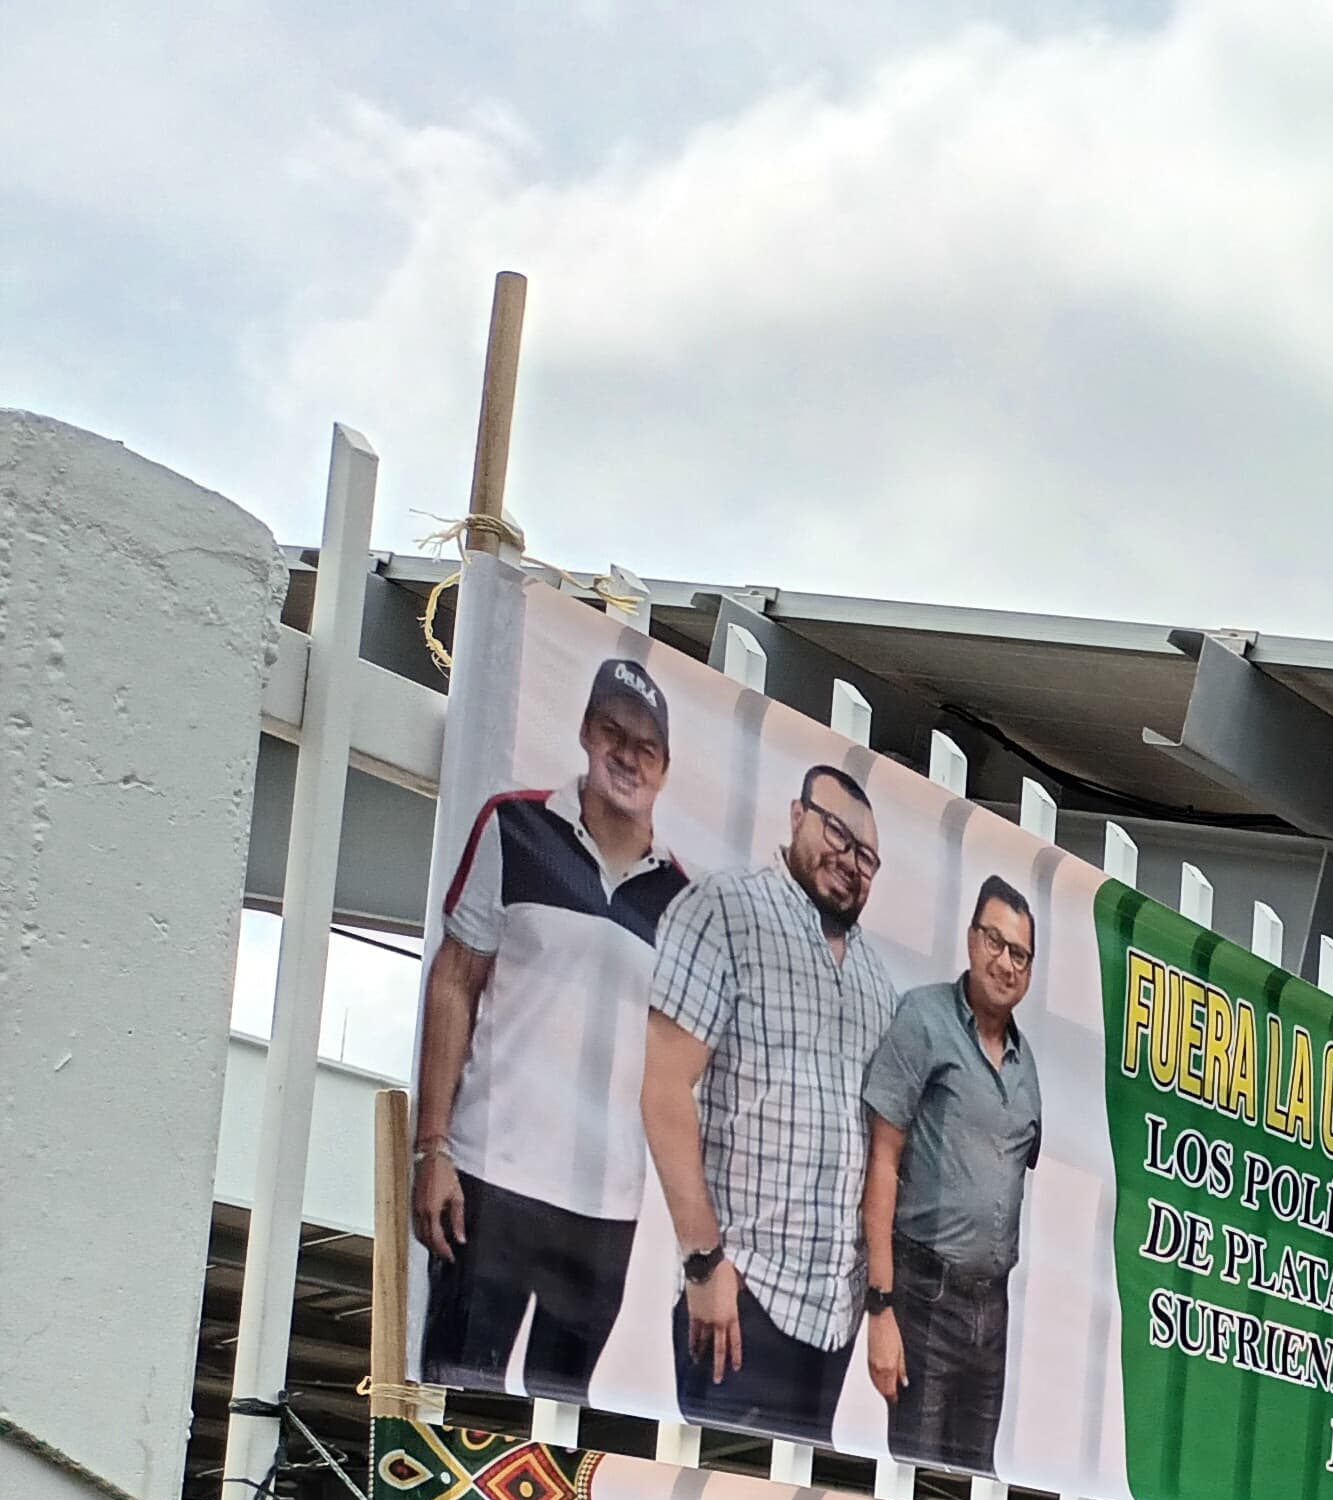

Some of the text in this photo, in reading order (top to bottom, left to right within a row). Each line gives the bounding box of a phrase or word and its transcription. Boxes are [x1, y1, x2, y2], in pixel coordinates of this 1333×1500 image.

[1122, 947, 1256, 1125] FUERA
[1266, 1017, 1313, 1146] LA
[1145, 1115, 1233, 1199] LOS
[1140, 1200, 1214, 1275] DE
